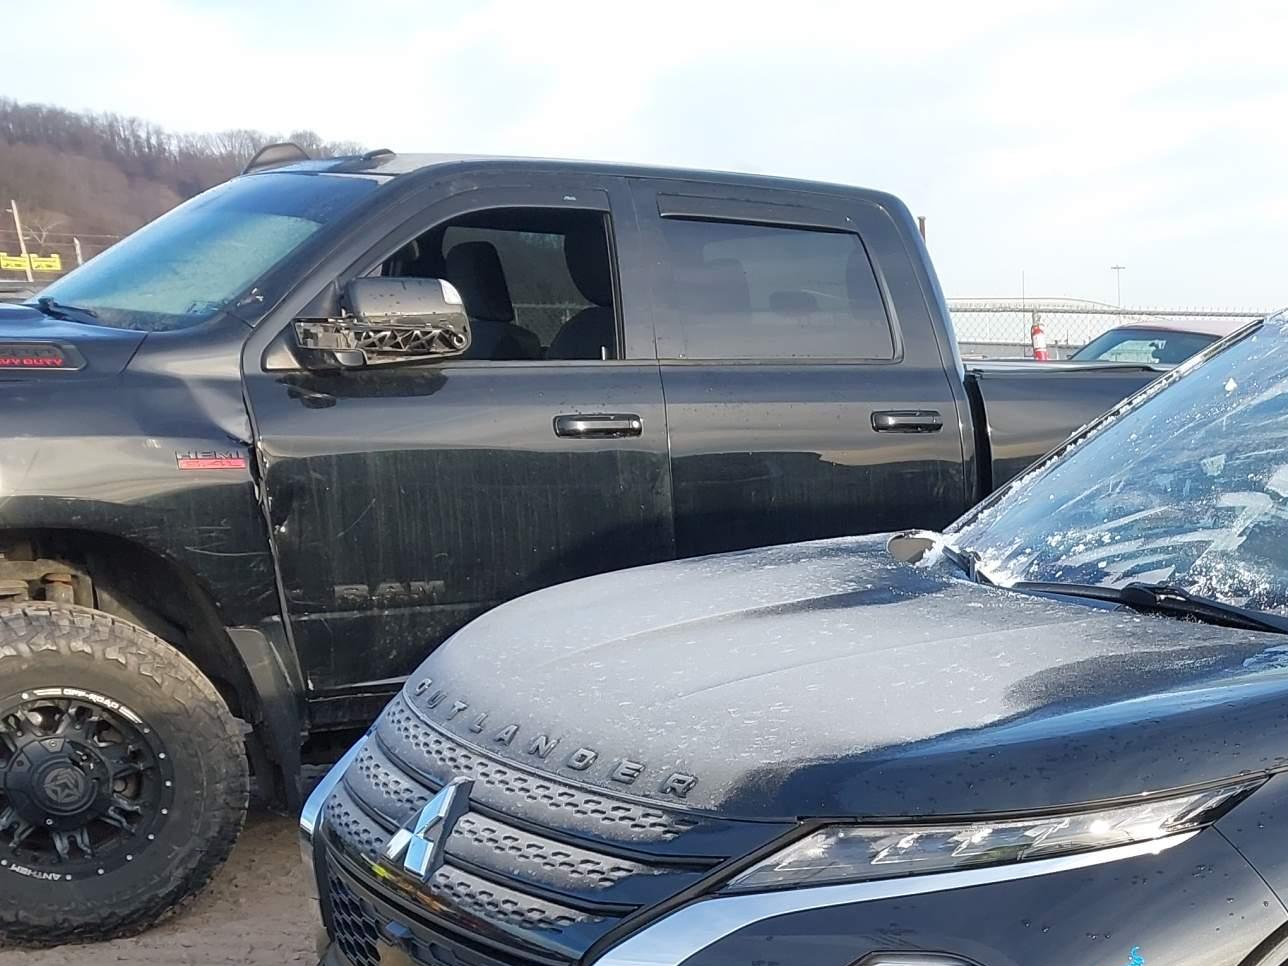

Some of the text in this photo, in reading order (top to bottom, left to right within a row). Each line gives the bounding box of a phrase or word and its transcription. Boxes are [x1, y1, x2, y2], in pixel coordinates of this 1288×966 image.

[23, 358, 63, 366] DUTY
[174, 450, 241, 460] HEMI
[334, 580, 445, 601] RAM
[63, 688, 120, 709] OFF-ROAD
[415, 677, 699, 798] OUTLANDER
